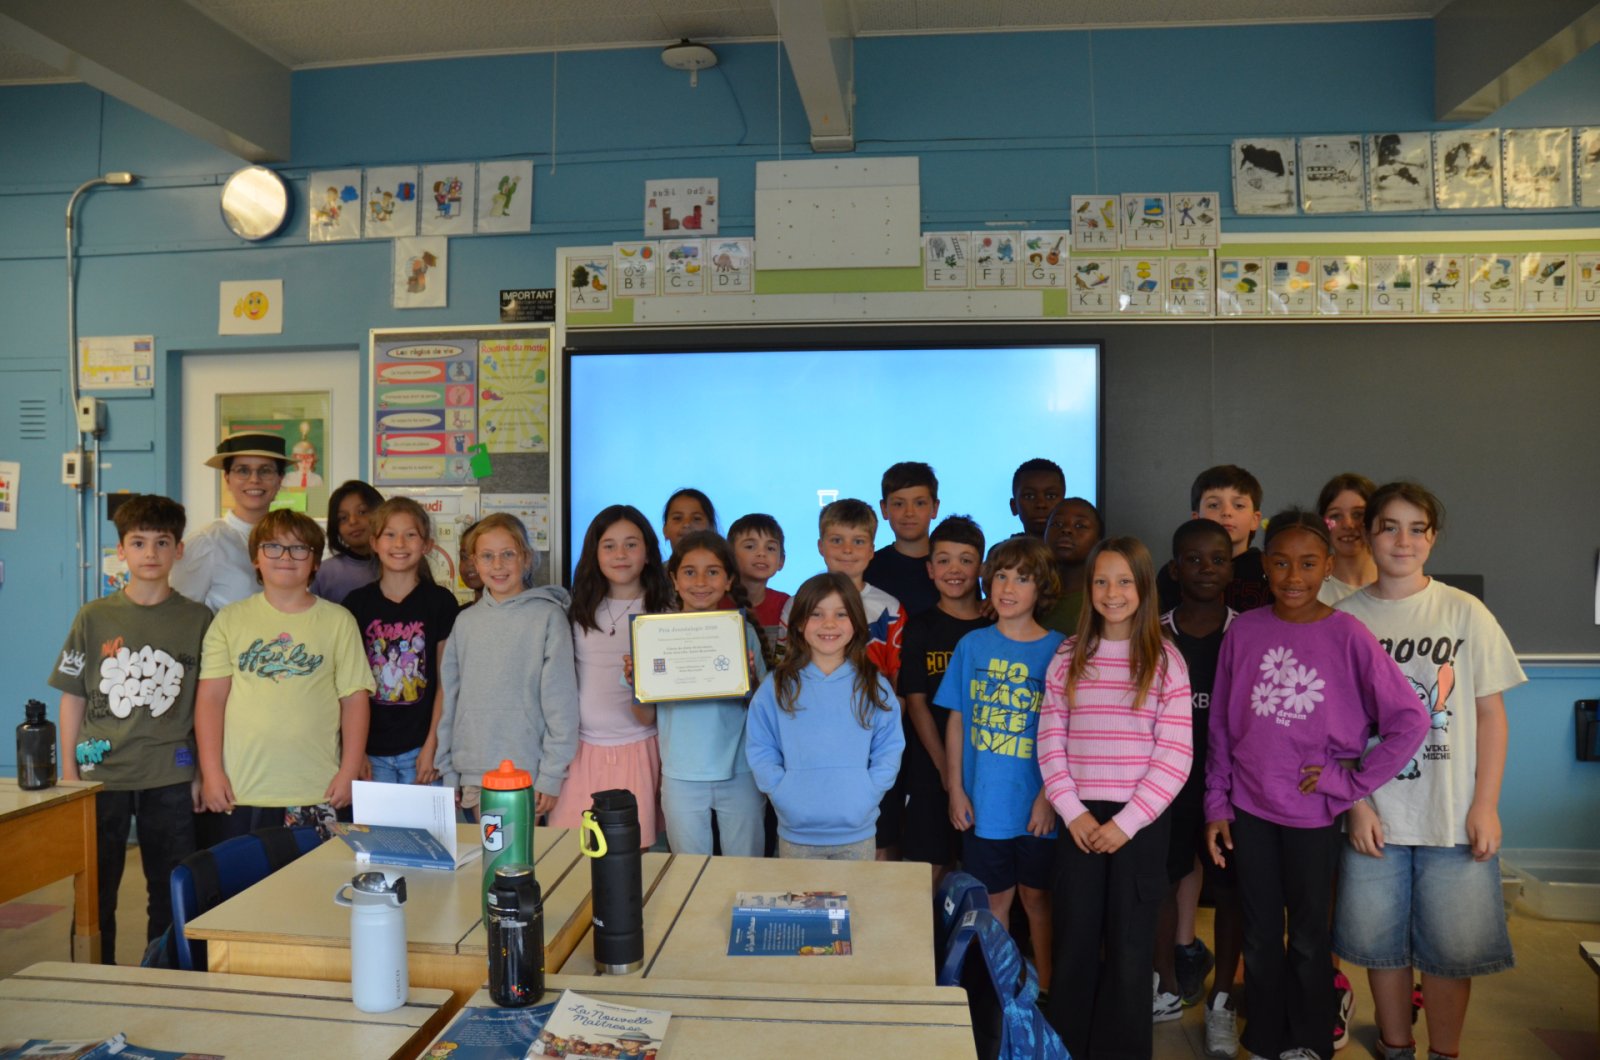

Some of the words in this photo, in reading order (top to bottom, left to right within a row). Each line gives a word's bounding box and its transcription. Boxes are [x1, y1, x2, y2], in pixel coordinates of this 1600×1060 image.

[1083, 231, 1093, 243] H
[1183, 229, 1190, 240] J
[719, 274, 729, 286] D
[934, 269, 941, 281] E
[983, 268, 992, 280] F
[1032, 268, 1045, 280] G
[1049, 273, 1056, 285] g
[624, 278, 633, 289] B
[671, 275, 681, 287] C
[502, 290, 555, 301] IMPORTANT
[576, 293, 585, 304] A
[1079, 294, 1088, 306] K
[1129, 294, 1138, 306] L
[1173, 295, 1187, 306] M
[1279, 292, 1290, 305] O
[1330, 292, 1338, 302] P
[1377, 293, 1390, 305] Q
[1431, 292, 1441, 305] R
[1482, 291, 1491, 304] S
[1533, 290, 1544, 303] T
[1585, 290, 1596, 302] U
[481, 344, 511, 353] Routine
[512, 343, 523, 352] du
[524, 342, 547, 353] matin
[422, 500, 443, 512] udi
[99, 644, 185, 697] SKATE
[987, 658, 1029, 684] NO
[108, 678, 176, 719] CREW
[970, 679, 1043, 713] PLACE
[972, 703, 1028, 734] LIKE
[1276, 709, 1307, 720] dream
[1276, 716, 1291, 727] big
[1424, 744, 1450, 753] WICKE
[480, 814, 504, 852] G
[568, 1004, 591, 1015] La
[591, 1009, 654, 1025] Nouvelle
[572, 1014, 644, 1032] Maîtresse
